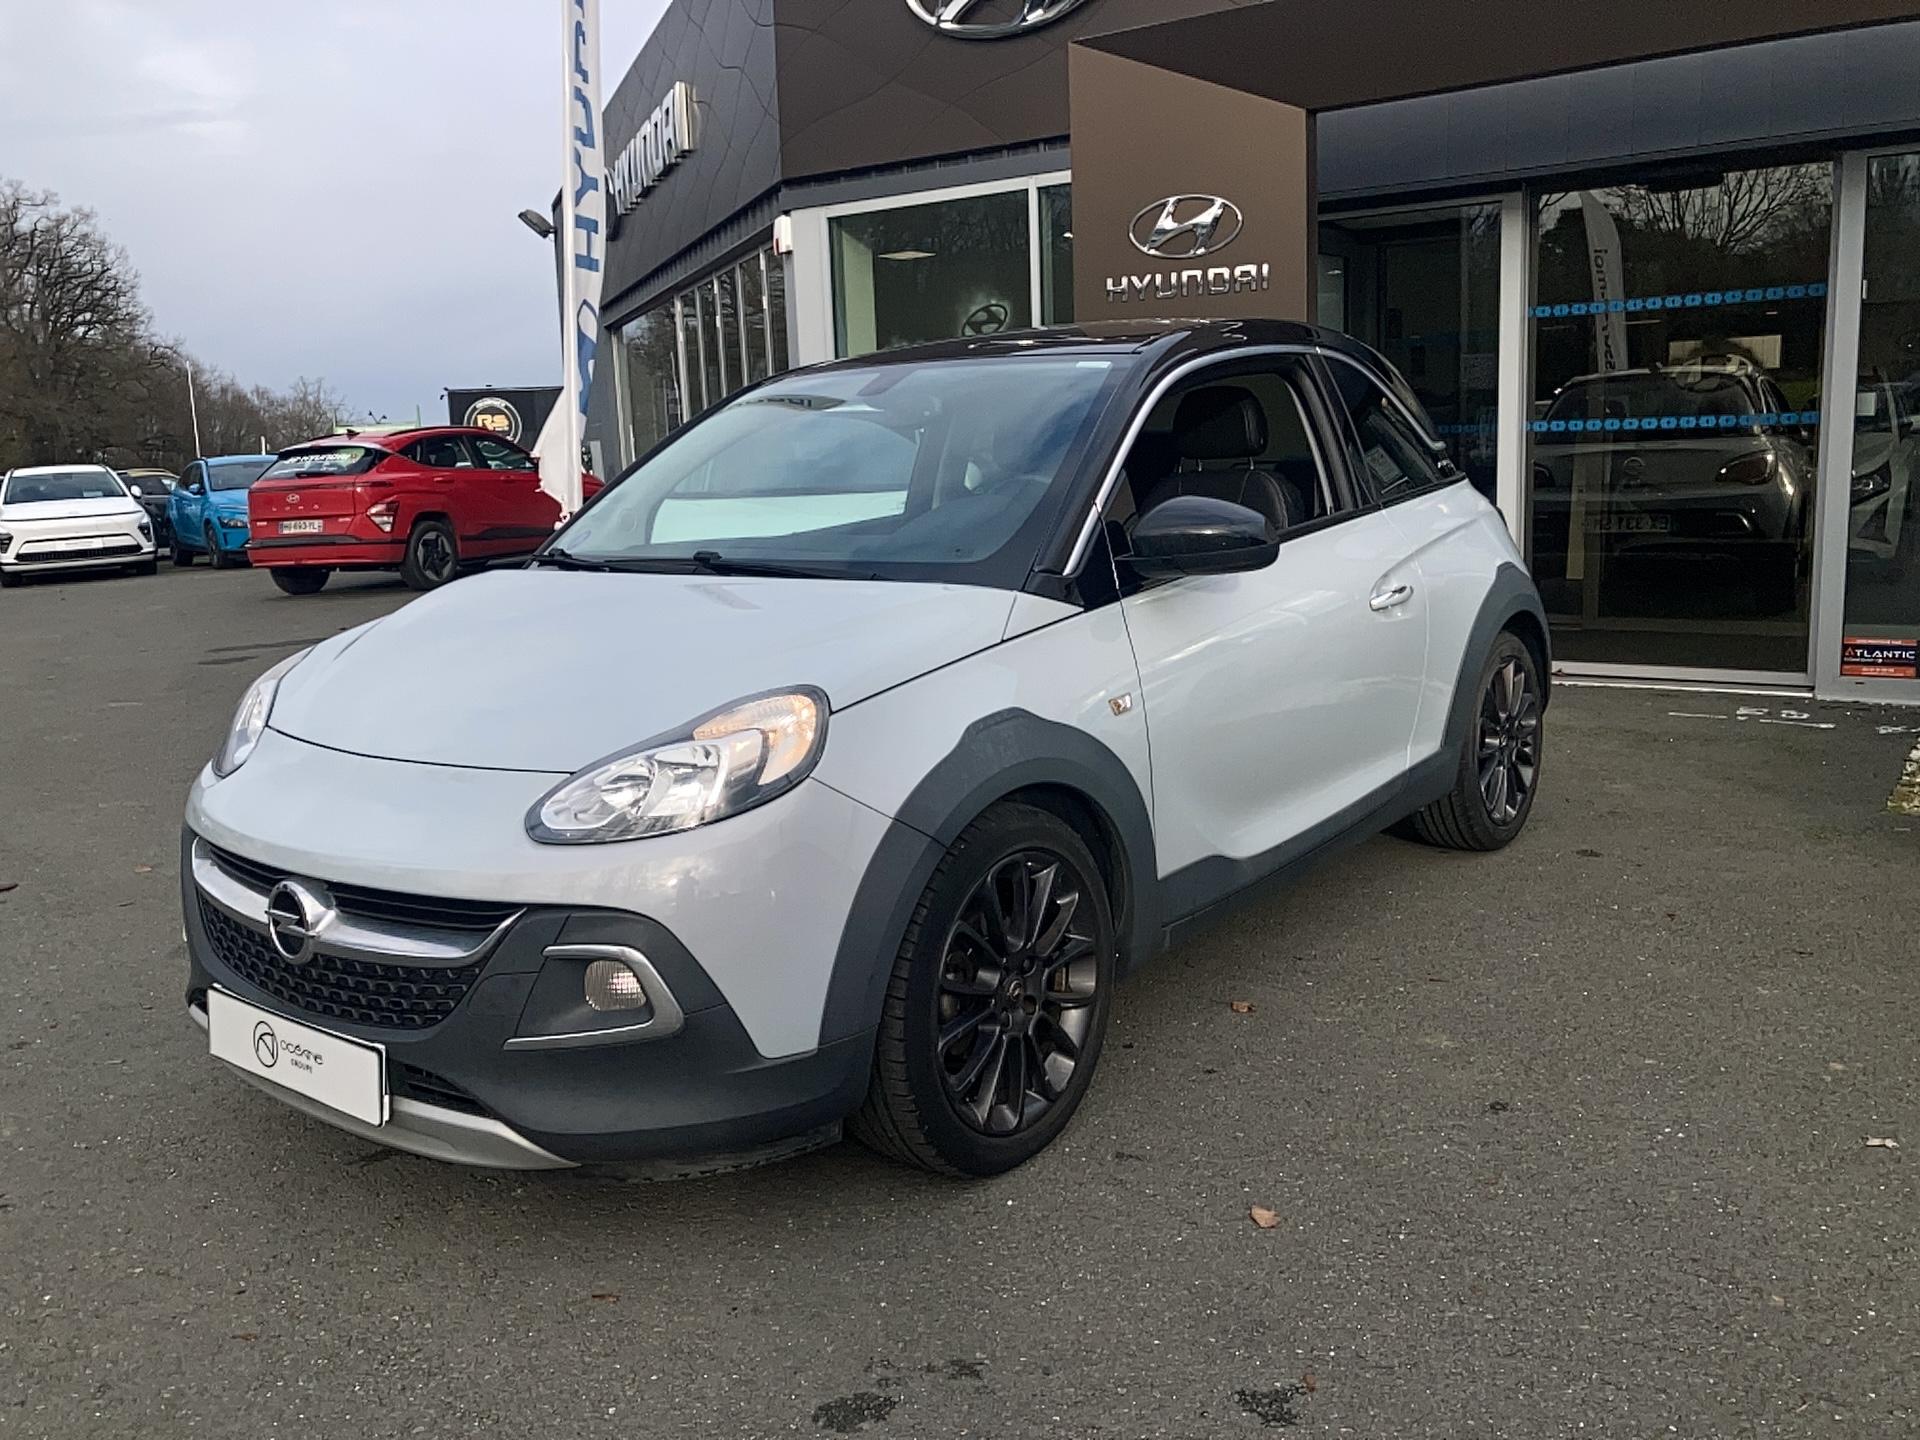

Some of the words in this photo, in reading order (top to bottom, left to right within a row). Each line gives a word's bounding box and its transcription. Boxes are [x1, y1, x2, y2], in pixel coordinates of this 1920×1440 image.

[614, 81, 691, 216] HYUNDAI
[1105, 262, 1270, 302] HYUNDAI
[1844, 646, 1916, 660] ATLANTIC
